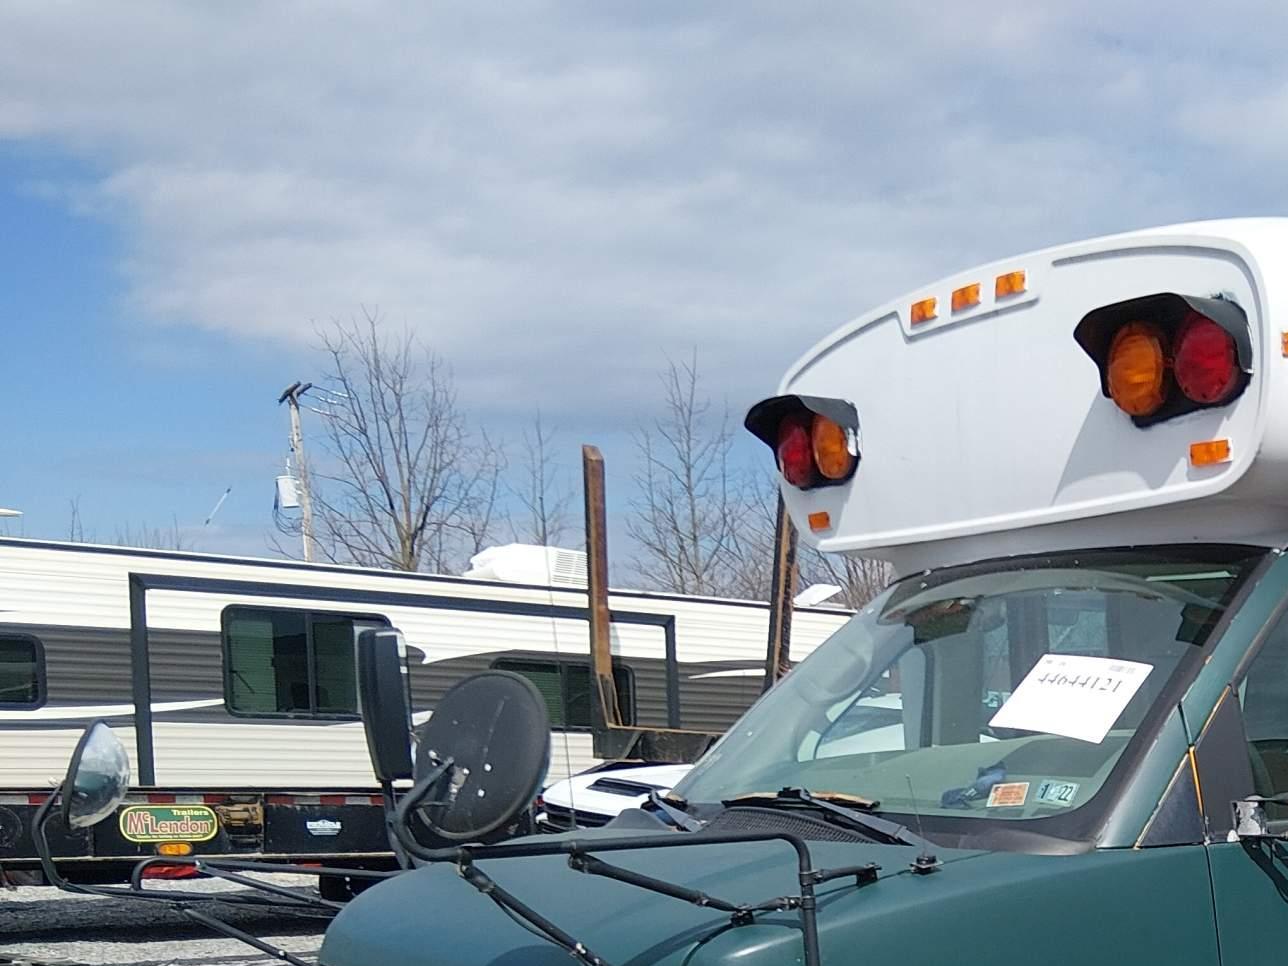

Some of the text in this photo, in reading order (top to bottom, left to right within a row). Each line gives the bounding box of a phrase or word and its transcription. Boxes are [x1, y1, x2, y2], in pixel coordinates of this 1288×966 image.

[1038, 672, 1123, 692] 44644121
[1058, 784, 1074, 801] 22
[127, 811, 210, 834] McLendon
